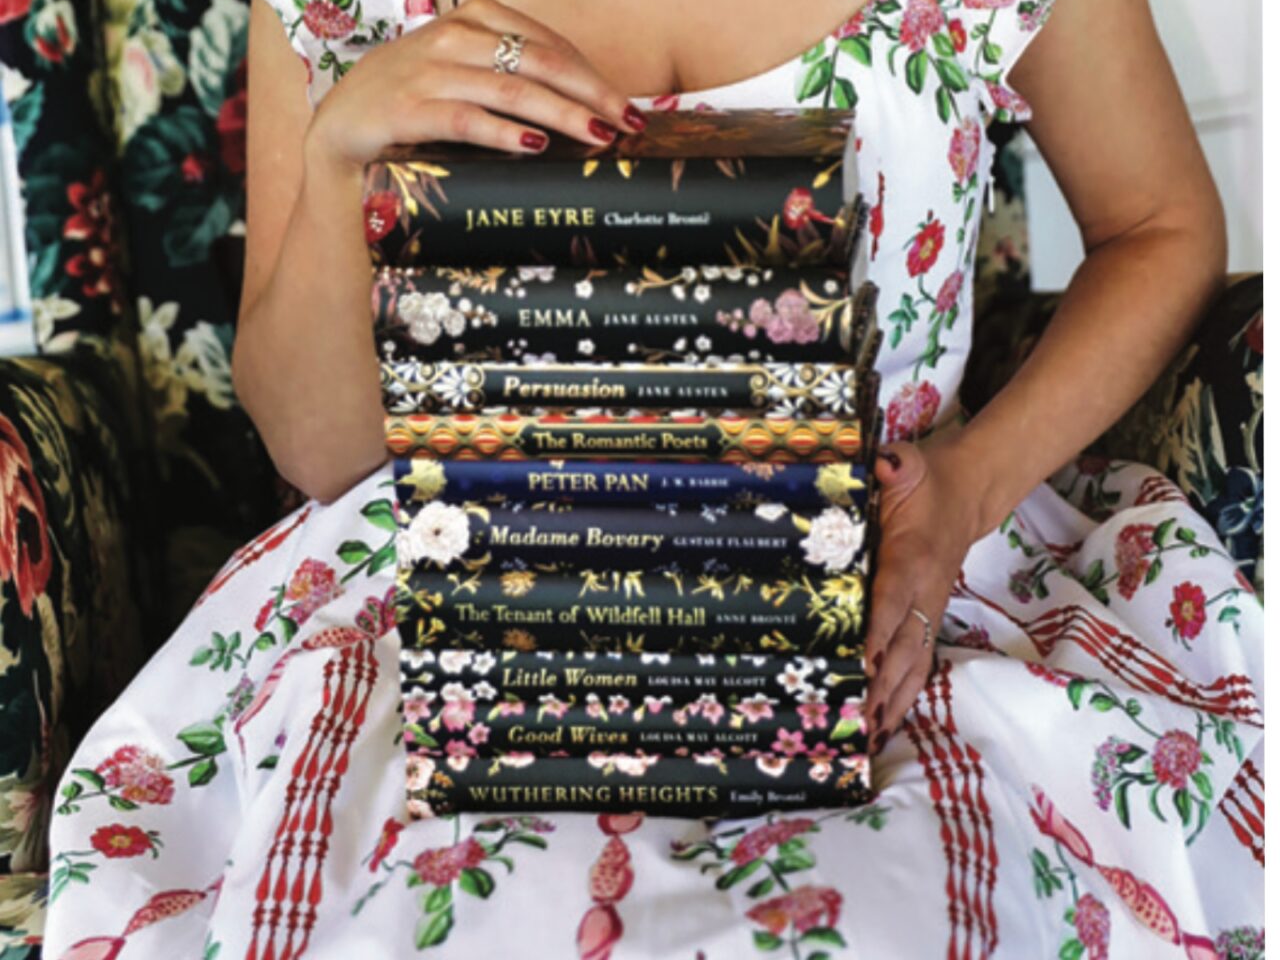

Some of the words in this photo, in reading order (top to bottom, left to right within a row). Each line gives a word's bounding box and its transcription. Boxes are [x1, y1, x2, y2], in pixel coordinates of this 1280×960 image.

[465, 208, 523, 230] JANE
[534, 208, 594, 227] EYRE
[604, 211, 664, 225] Charlotte
[519, 309, 591, 327] EMMA
[605, 314, 639, 325] JANE
[645, 314, 698, 325] AUSTEN
[503, 377, 625, 398] Persuasion
[638, 386, 670, 397] JANE
[678, 386, 728, 397] AUSTEN
[533, 433, 567, 449] The
[573, 433, 656, 449] Romantic
[662, 433, 708, 449] Poets
[529, 473, 598, 491] PETER
[605, 473, 648, 491] PAN
[491, 527, 579, 547] Madame
[586, 527, 664, 552] Bovary
[673, 537, 723, 547] GUSTAVE
[728, 537, 787, 547] FLAUBERT
[456, 604, 490, 622] The
[493, 604, 553, 623] Tenant
[559, 604, 580, 624] of
[587, 605, 661, 626] Wildfell
[667, 606, 706, 626] Hall
[715, 614, 746, 624] ANNE
[503, 669, 558, 687] Little
[564, 670, 637, 687] Women
[649, 675, 690, 686] LOUISA
[694, 675, 717, 686] MAY
[723, 675, 766, 687] ALCOTT
[508, 725, 566, 745] Good
[570, 725, 629, 744] Wives
[640, 732, 682, 742] LOUISA
[687, 732, 708, 742] MAY
[715, 732, 758, 742] ALCOTT
[469, 785, 611, 804] WUTHERING
[619, 785, 718, 803] HEIGHTS
[730, 791, 763, 804] Emily
